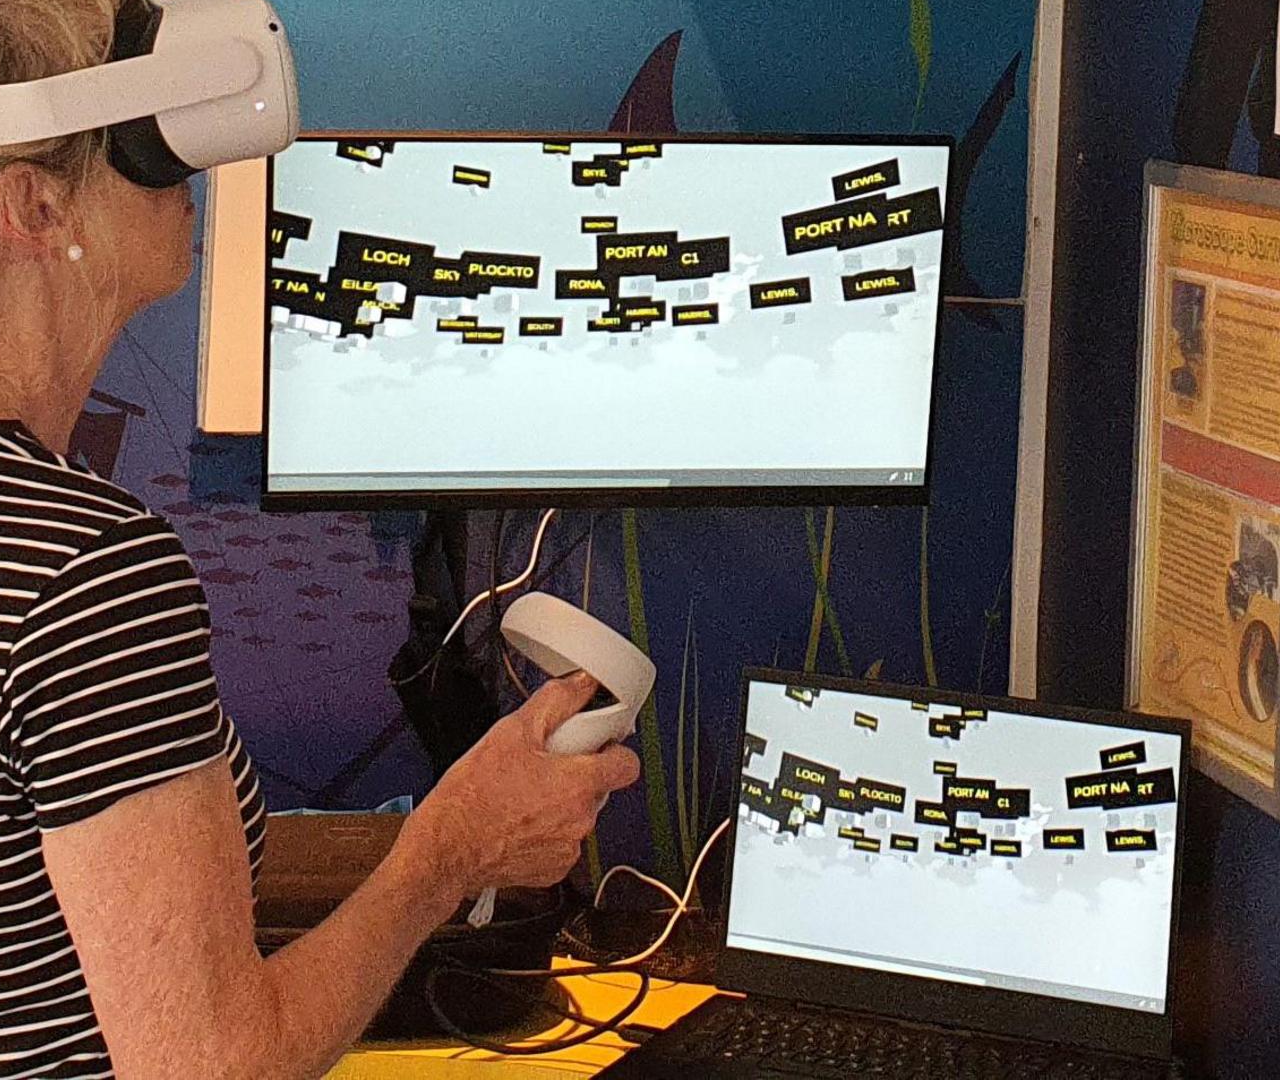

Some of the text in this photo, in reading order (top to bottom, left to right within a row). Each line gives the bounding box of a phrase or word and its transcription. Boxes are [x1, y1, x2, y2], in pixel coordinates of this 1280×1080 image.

[794, 211, 877, 240] PORT NA
[362, 248, 411, 267] LOCH
[605, 245, 668, 259] PORT AN
[681, 252, 699, 264] C1
[469, 262, 534, 278] PLOCKTO
[286, 280, 310, 294] NA
[795, 767, 826, 785] LOCH
[860, 787, 902, 805] PLOCKTO
[948, 787, 990, 799] PORT AN
[1074, 780, 1131, 798] PORT NA
